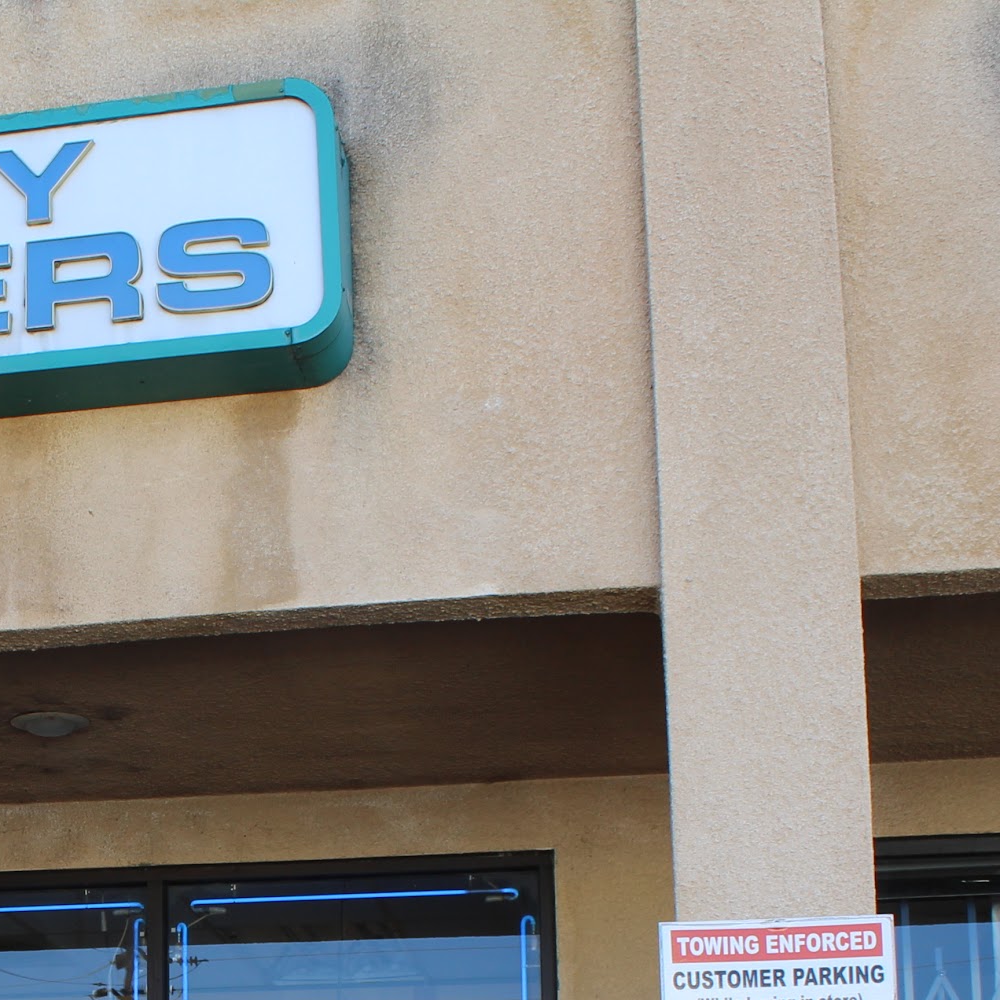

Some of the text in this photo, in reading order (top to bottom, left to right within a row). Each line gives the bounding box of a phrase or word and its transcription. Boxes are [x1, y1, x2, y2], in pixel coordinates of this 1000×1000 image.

[676, 930, 878, 957] TOWING ENFORCED
[672, 964, 885, 990] CUSTOMER PARKING
